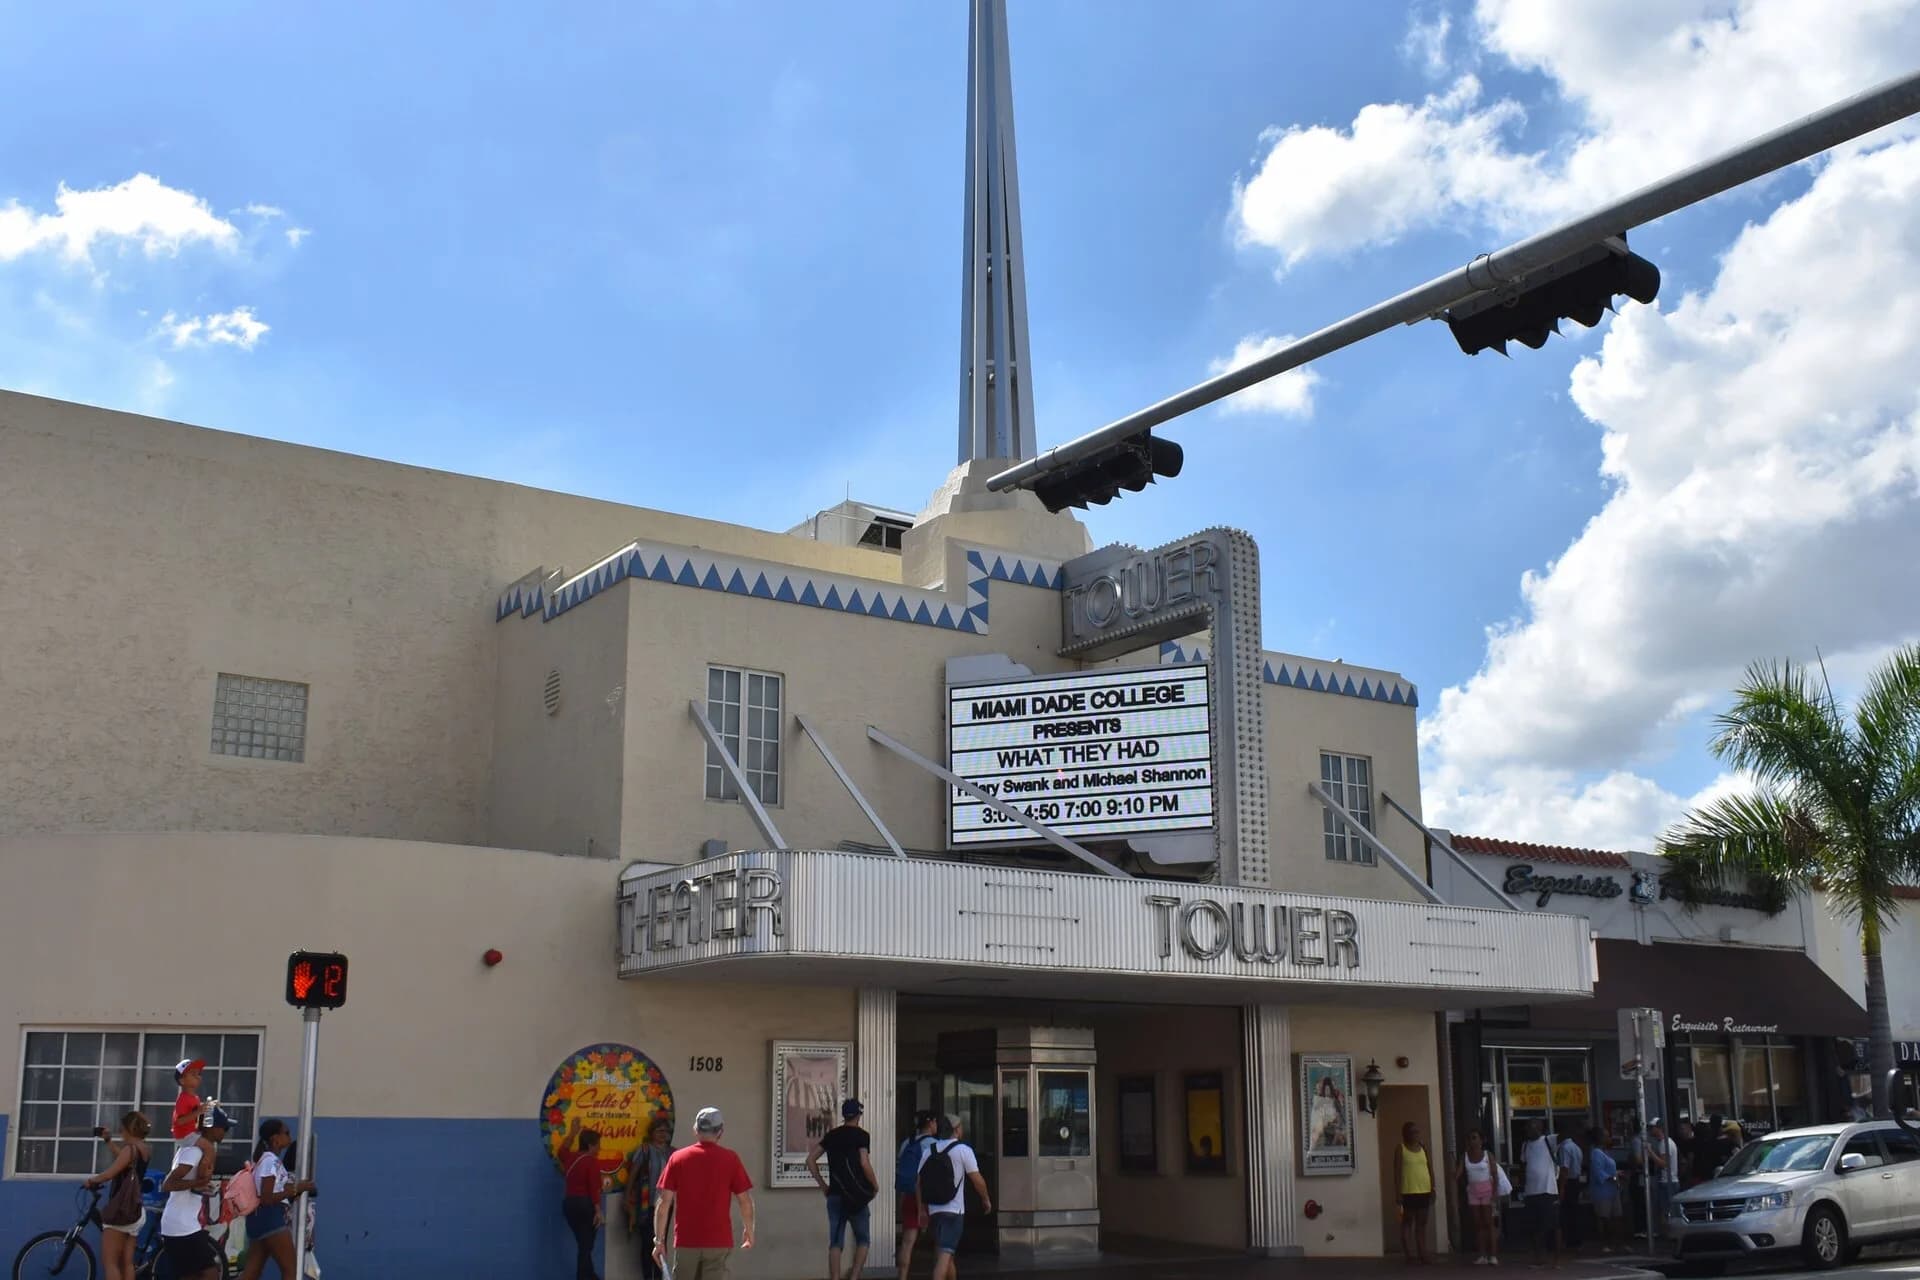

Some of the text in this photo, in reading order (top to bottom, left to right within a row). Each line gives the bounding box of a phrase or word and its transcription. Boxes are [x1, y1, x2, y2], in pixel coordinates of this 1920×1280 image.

[1065, 540, 1224, 637] TOWER
[971, 684, 1186, 720] MIAMI DADE COLLEGE
[1032, 717, 1122, 740] PRESENTS
[996, 739, 1160, 769] WHAT THEY HAD
[1002, 777, 1050, 794] Swank
[1052, 774, 1080, 791] and
[1083, 770, 1139, 788] Michael
[1142, 767, 1207, 784] Shannon
[1023, 802, 1060, 821] 4:50
[1065, 800, 1102, 819] 7:00
[1106, 797, 1145, 816] 9:10
[1150, 794, 1179, 813] PM
[1503, 863, 1624, 908] Exquisito
[616, 867, 785, 957] THEATER
[1145, 894, 1360, 969] TOWER
[324, 964, 343, 997] 12
[1671, 1013, 1719, 1033] Exquisito
[1722, 1016, 1779, 1033] Restaurant
[689, 1055, 724, 1072] 1508
[575, 1087, 636, 1110] Calle 8
